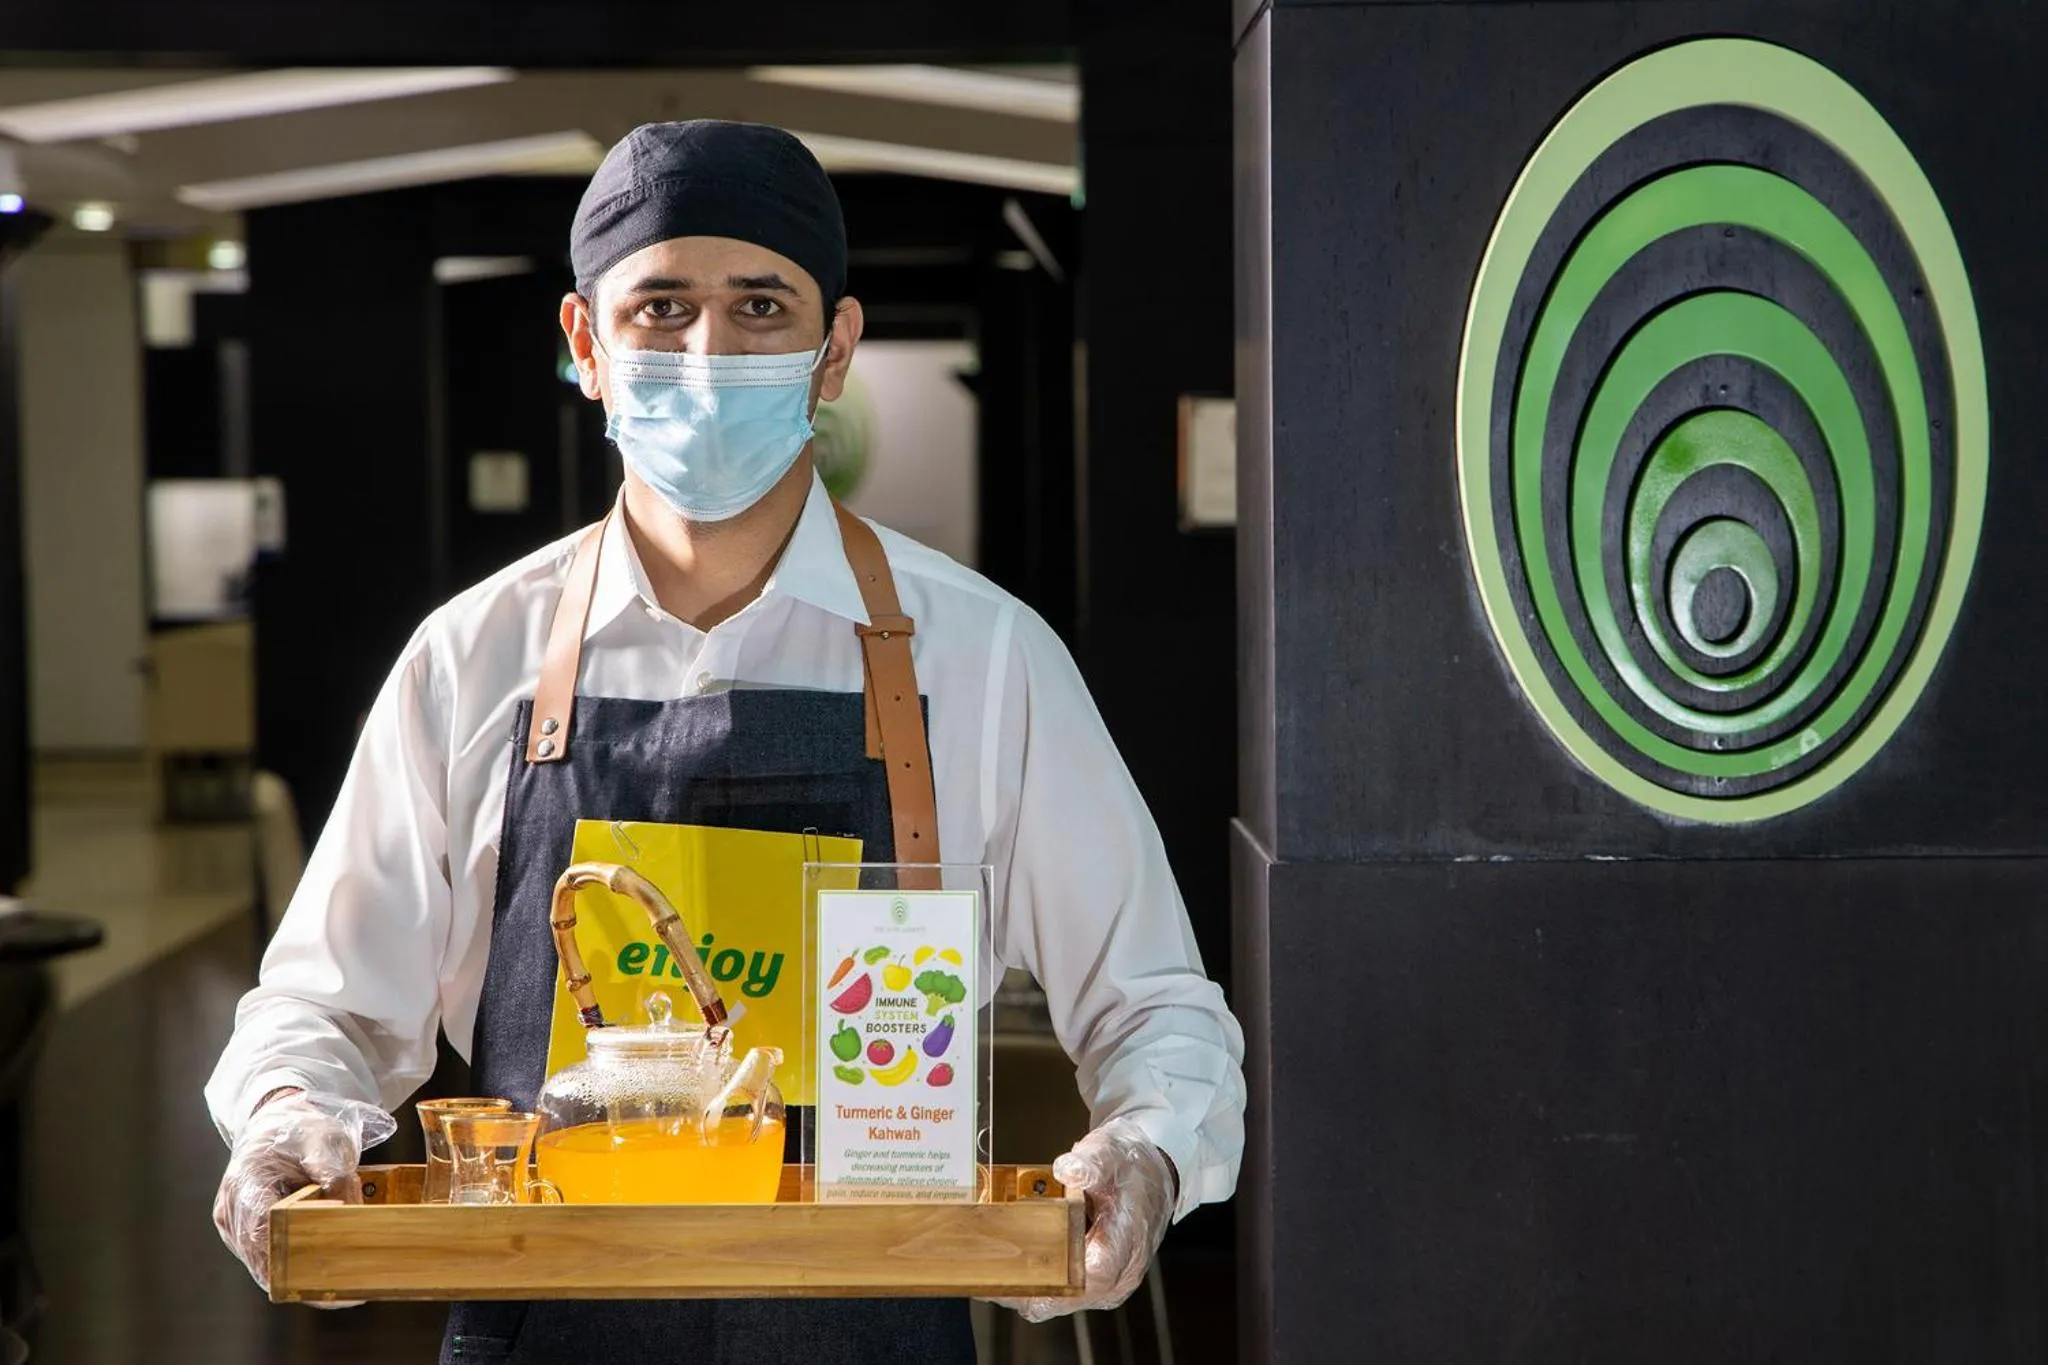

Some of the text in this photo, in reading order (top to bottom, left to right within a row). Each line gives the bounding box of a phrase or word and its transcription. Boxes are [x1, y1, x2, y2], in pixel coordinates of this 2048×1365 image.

[875, 997, 918, 1008] IMMUNE
[875, 1010, 918, 1020] SYSTEM
[866, 1022, 927, 1033] BOOSTERS
[835, 1104, 955, 1123] Turmeric & Ginger
[868, 1126, 921, 1140] Kahwah
[844, 1149, 951, 1160] Ginger and turmeric helps
[851, 1163, 945, 1173] decreasing markers of
[915, 1190, 932, 1199] and
